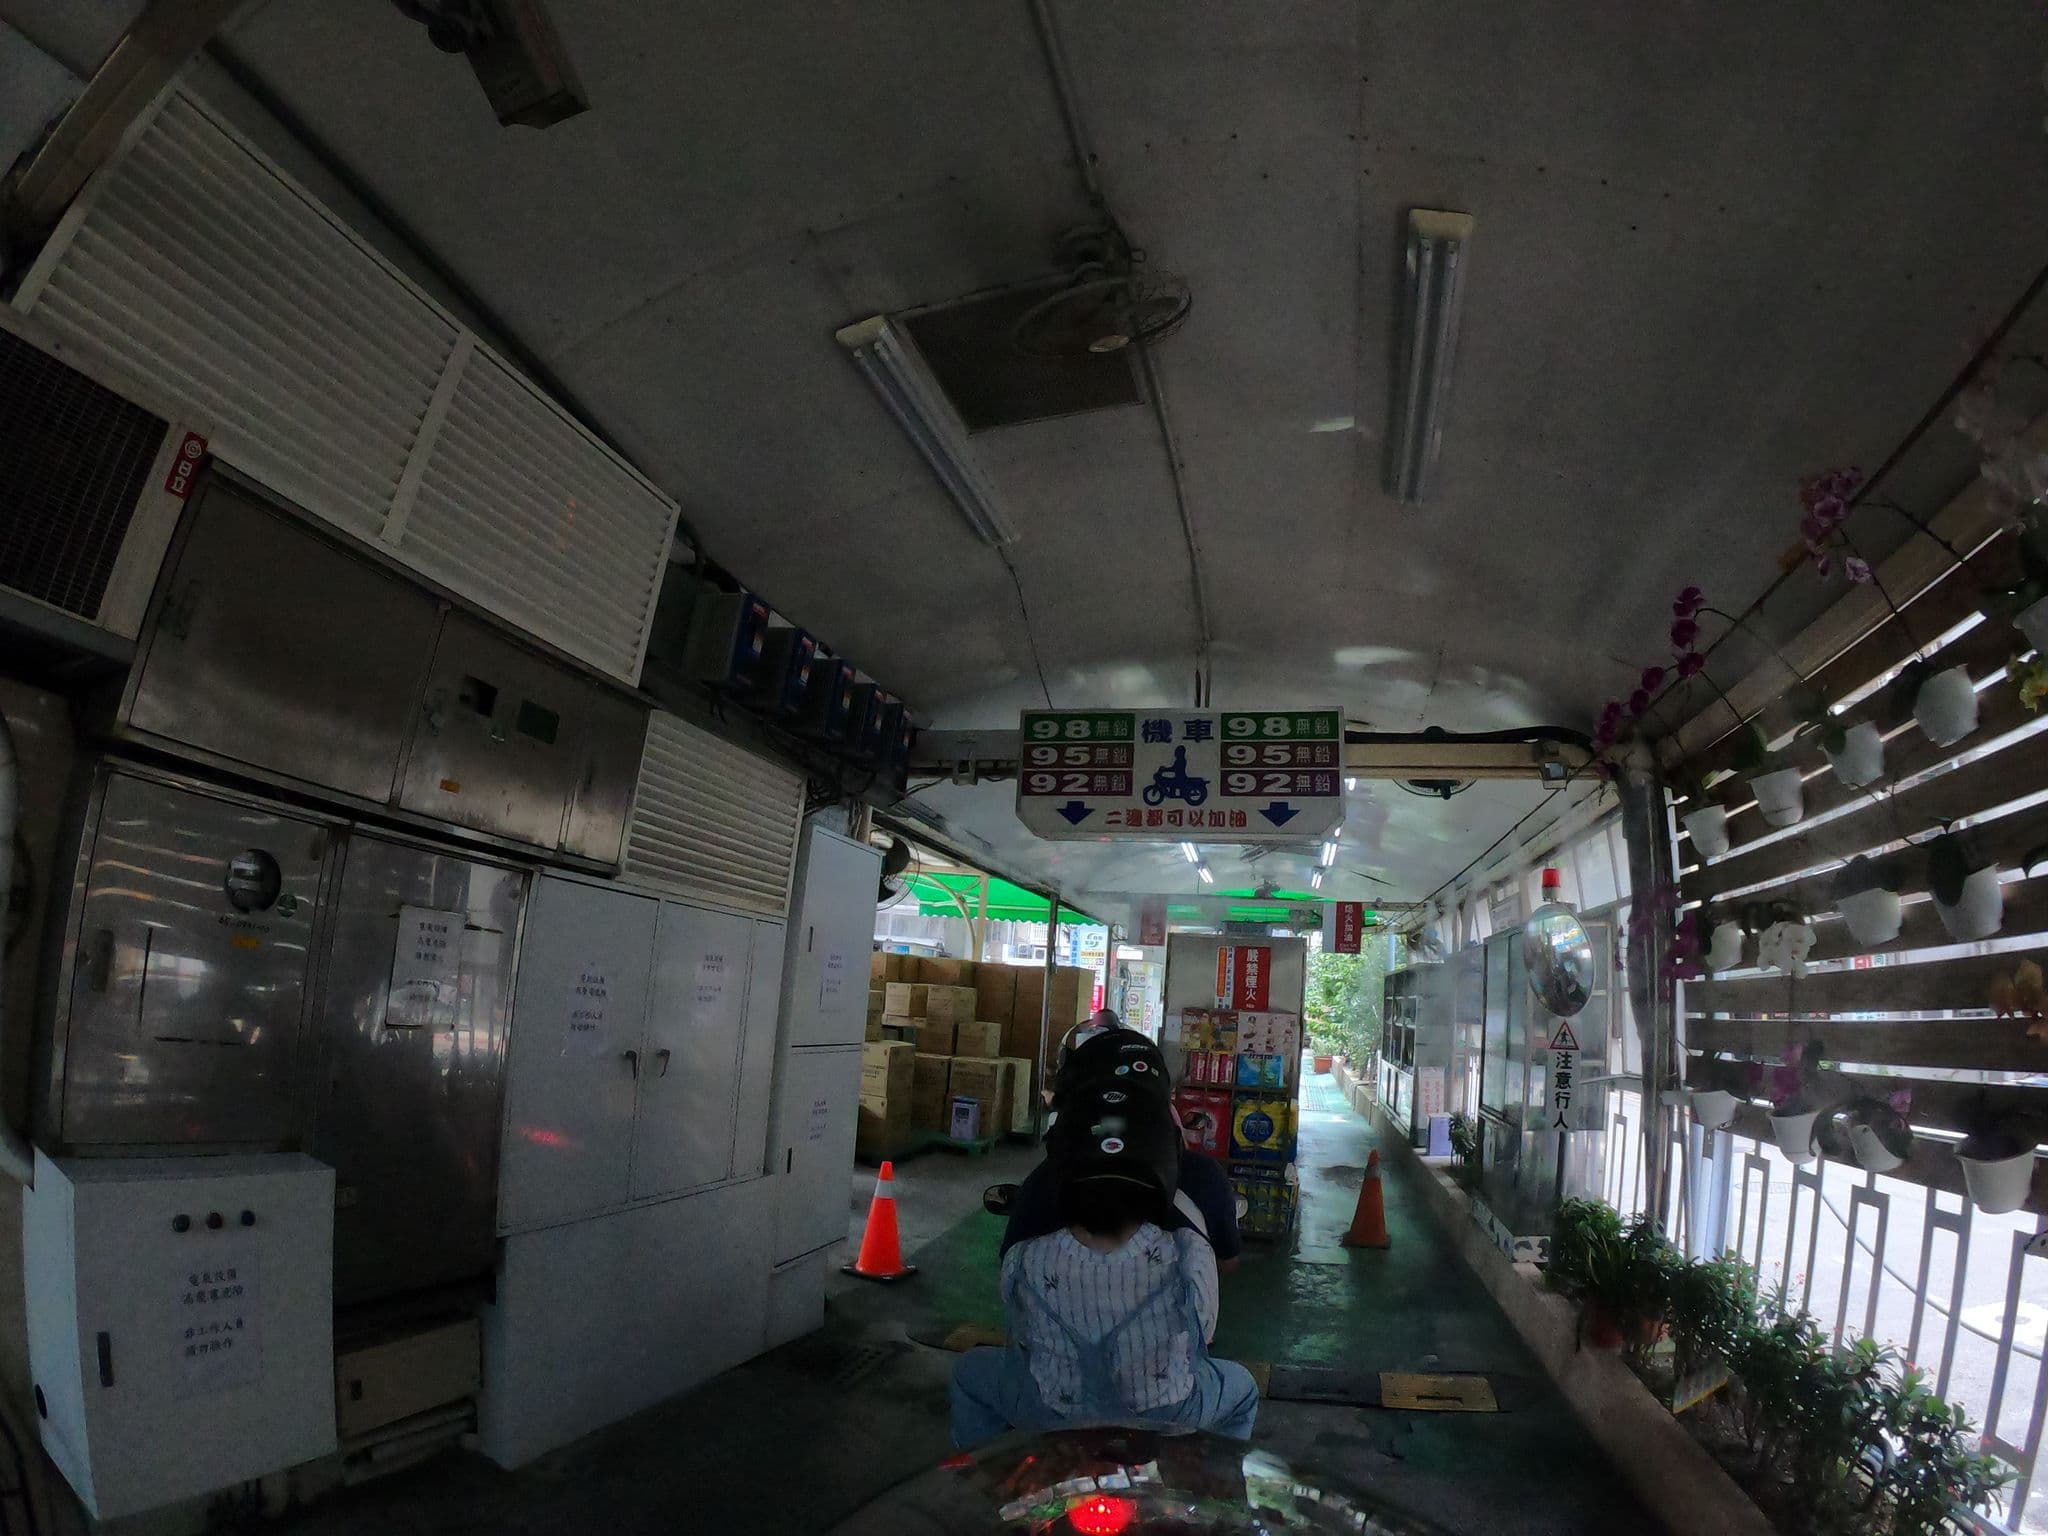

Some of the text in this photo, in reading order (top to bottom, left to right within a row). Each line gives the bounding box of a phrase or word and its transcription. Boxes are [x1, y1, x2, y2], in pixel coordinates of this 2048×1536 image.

[1141, 718, 1214, 743] 機車
[1553, 1051, 1572, 1129] 注意行人
